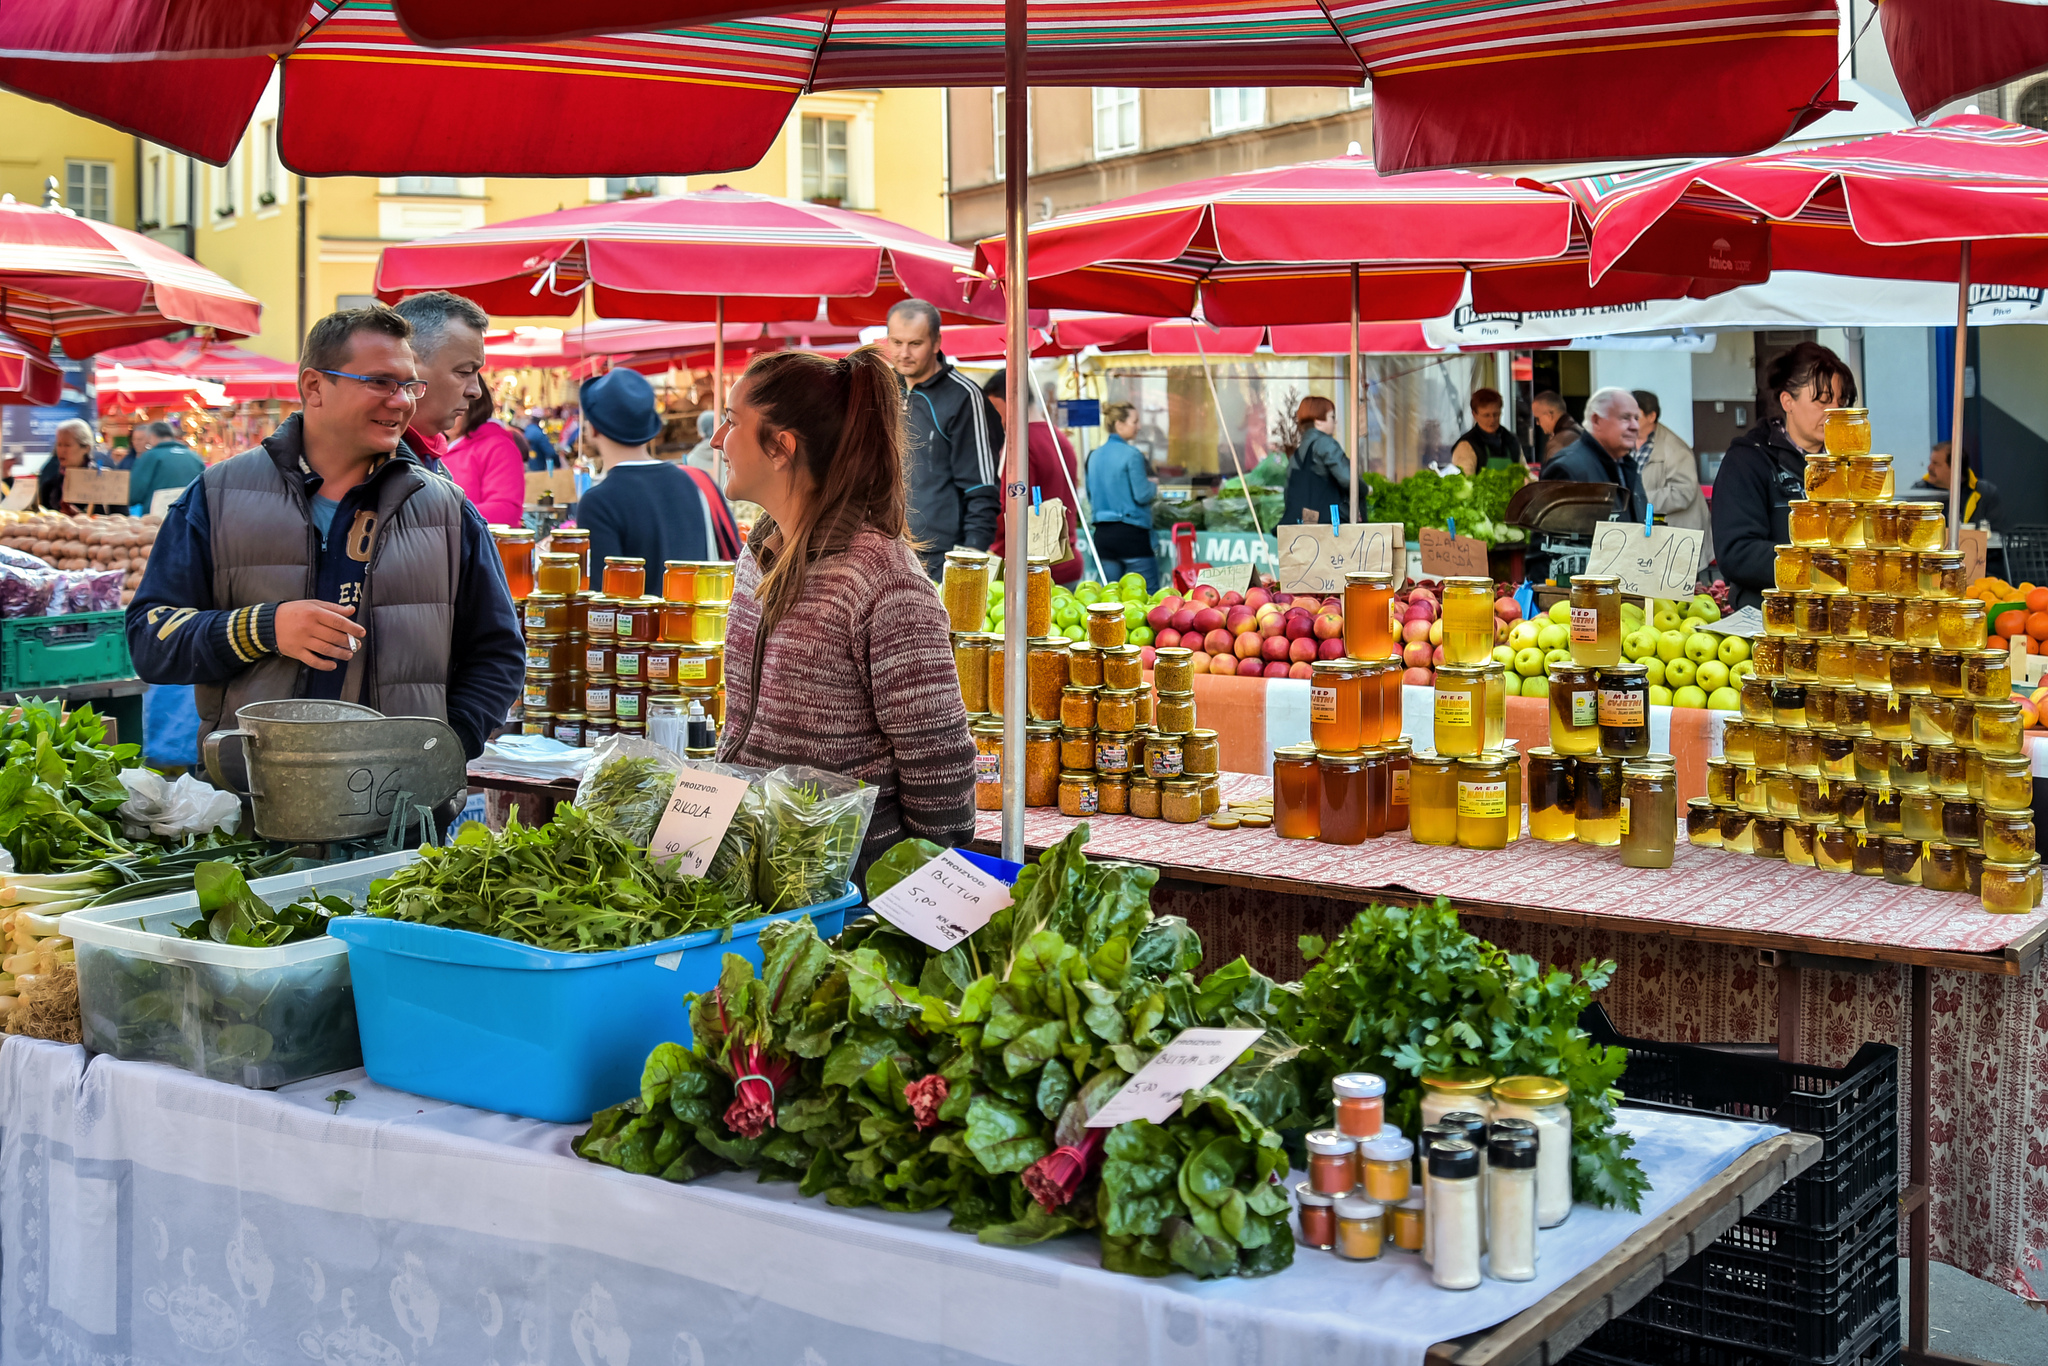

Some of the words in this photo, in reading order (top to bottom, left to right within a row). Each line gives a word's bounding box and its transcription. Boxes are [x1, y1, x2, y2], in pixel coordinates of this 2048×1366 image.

[1286, 534, 1325, 591] 2
[1654, 533, 1695, 592] 10
[338, 768, 401, 817] 96
[679, 781, 719, 794] PROIZVOD:
[665, 841, 680, 853] 40
[941, 857, 987, 888] PROIZVOD:
